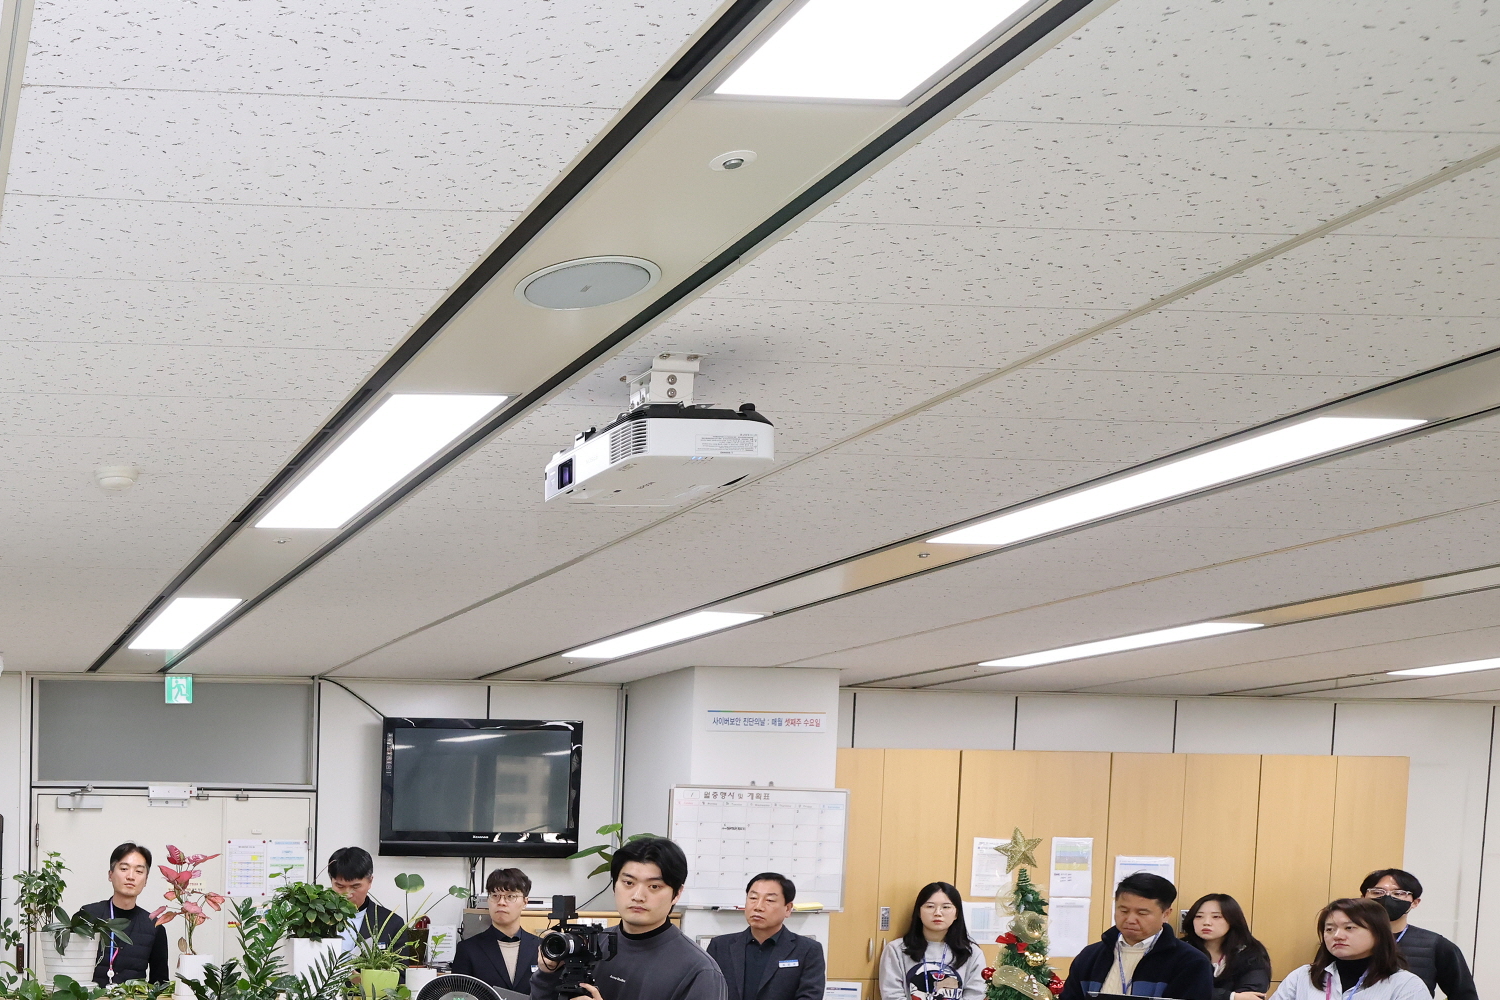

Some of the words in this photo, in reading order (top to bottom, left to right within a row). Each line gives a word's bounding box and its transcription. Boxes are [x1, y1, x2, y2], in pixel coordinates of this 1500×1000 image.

[713, 717, 741, 726] 사이버보안
[743, 718, 765, 726] 진단의날
[803, 719, 820, 727] 수요일
